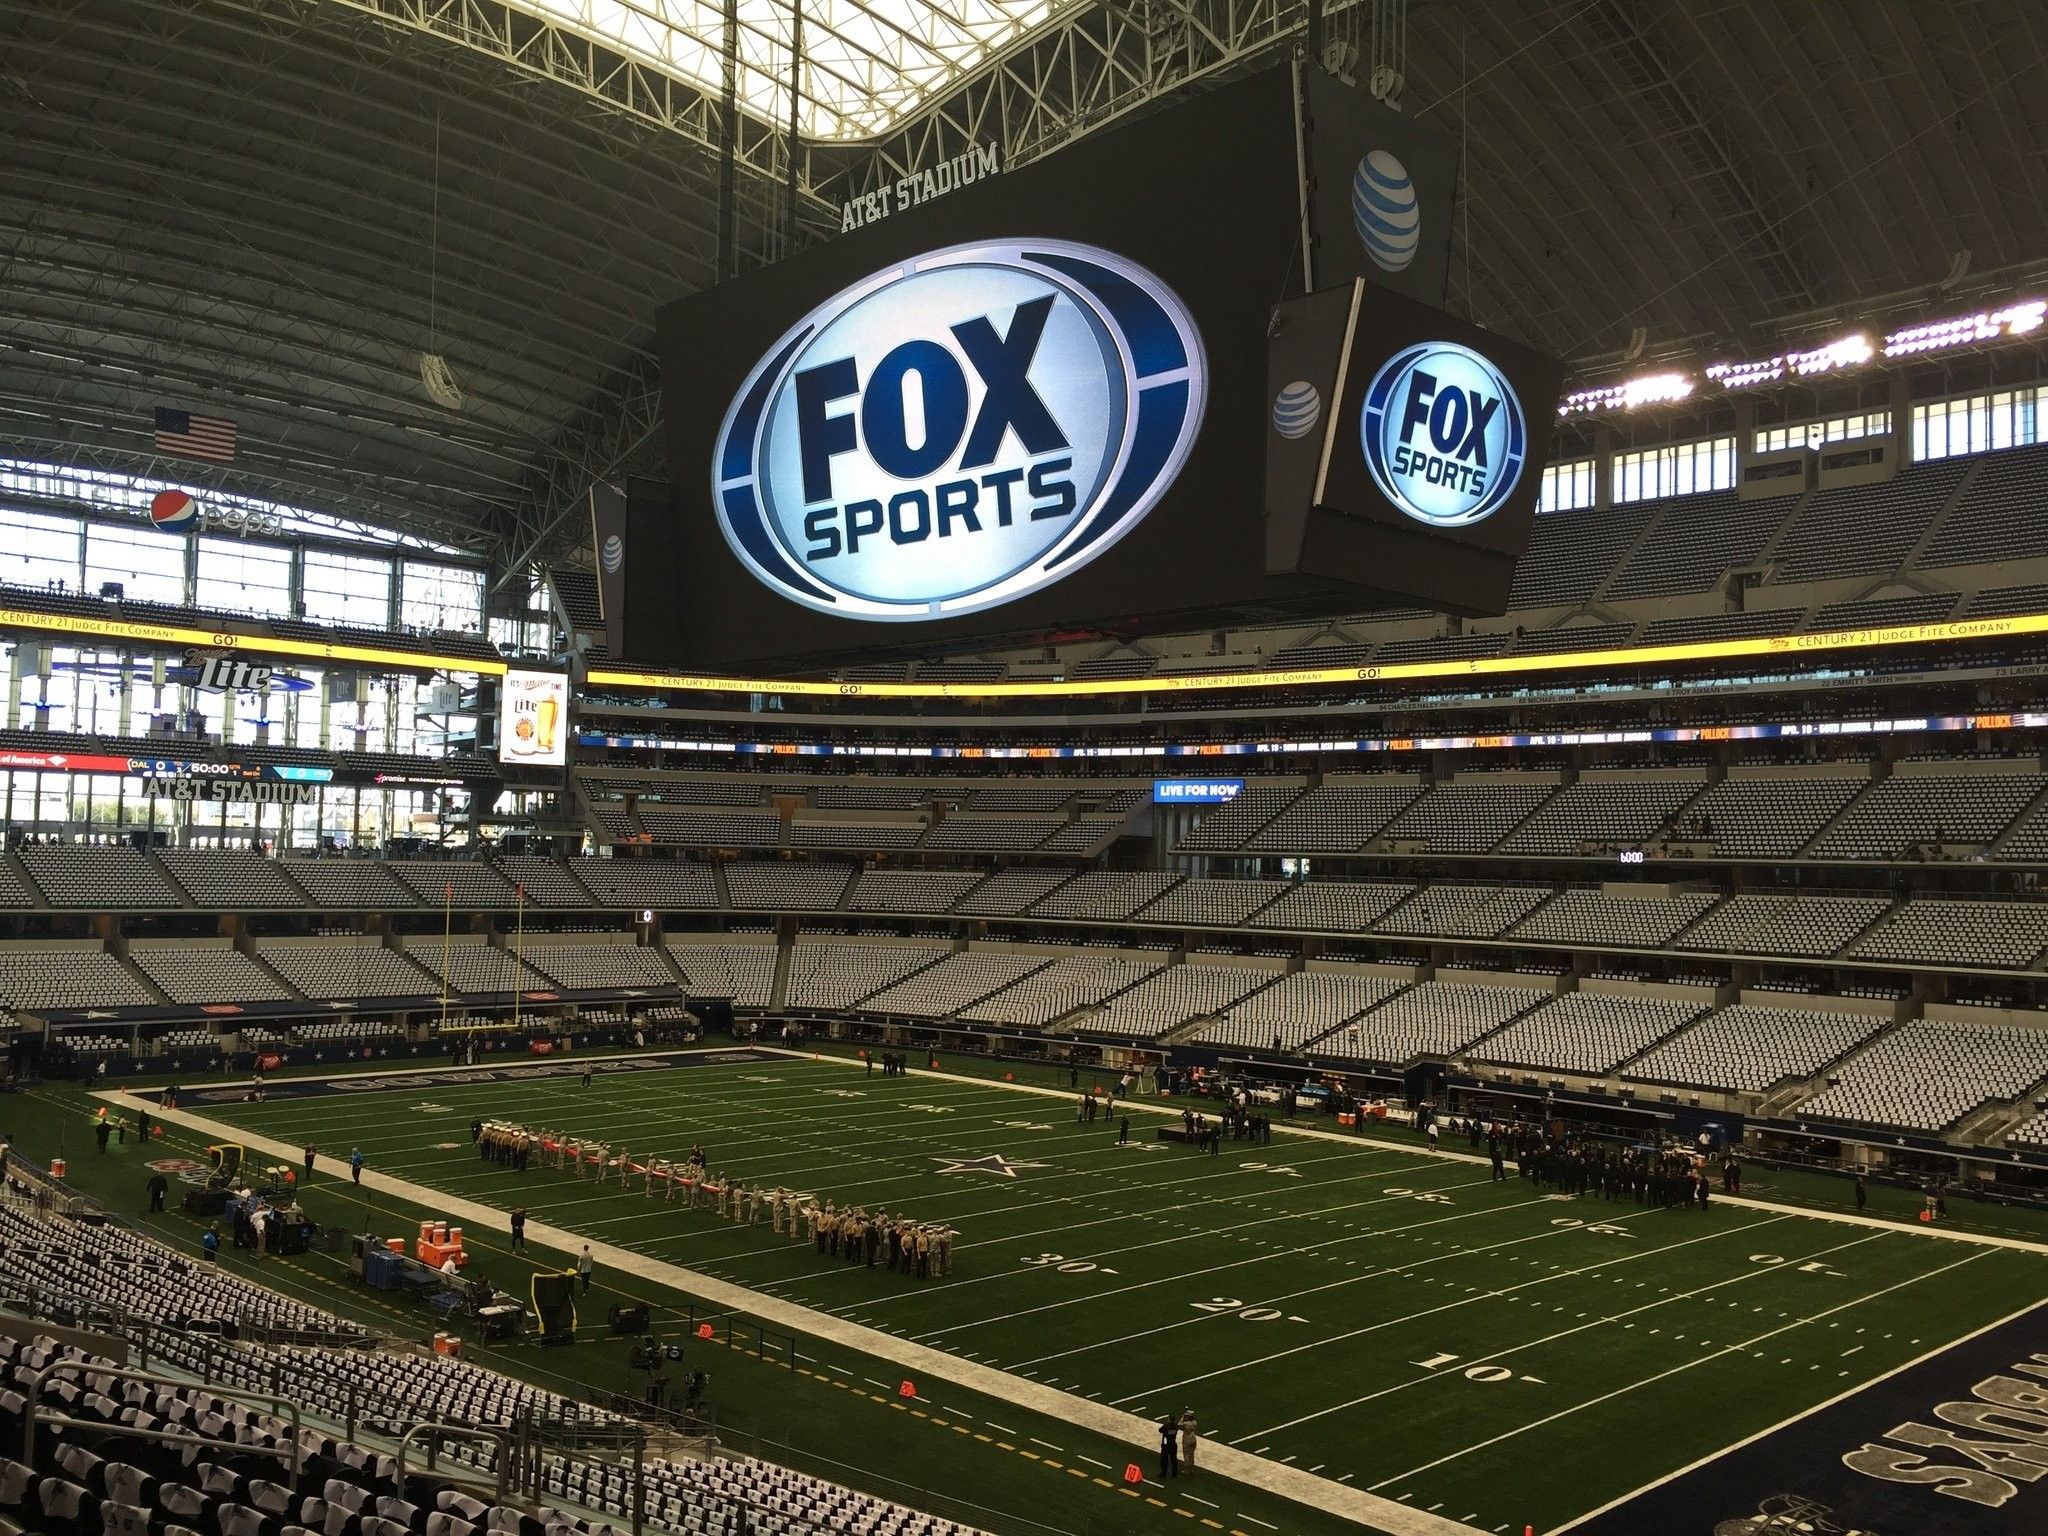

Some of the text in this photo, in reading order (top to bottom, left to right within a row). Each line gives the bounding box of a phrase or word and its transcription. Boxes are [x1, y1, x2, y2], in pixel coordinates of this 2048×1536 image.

[841, 141, 999, 233] AT&T STADIUM
[794, 292, 1070, 505] FOX
[1399, 368, 1501, 468] FOX
[1392, 446, 1487, 497] SPORTS
[805, 458, 1076, 561] SPORTS
[200, 506, 283, 538] pepsi
[2, 612, 175, 639] CENTURY 21 JUDGE FITE COMPANY
[1797, 633, 1855, 647] CENTURY
[1859, 630, 1873, 642] 21
[1877, 628, 1916, 645] JUDGE
[1919, 626, 1945, 637] FITE
[1948, 622, 2013, 636] COMPANY
[213, 635, 238, 647] GO!
[194, 658, 272, 694] Lite
[1357, 668, 1381, 680] GO!
[2010, 666, 2042, 675] LARRY
[840, 685, 862, 694] GO!
[514, 699, 537, 713] Lite
[1701, 728, 1729, 738] POLLOCK
[1976, 715, 2011, 727] POLLOCK
[191, 763, 229, 774] 60:00
[144, 777, 315, 804] AT&T STADIUM
[1160, 784, 1238, 797] LIVE FOR NOW
[1020, 1253, 1097, 1273] 30
[1190, 1297, 1282, 1321] 20
[1410, 1351, 1513, 1382] 10
[1126, 1465, 1137, 1479] 10
